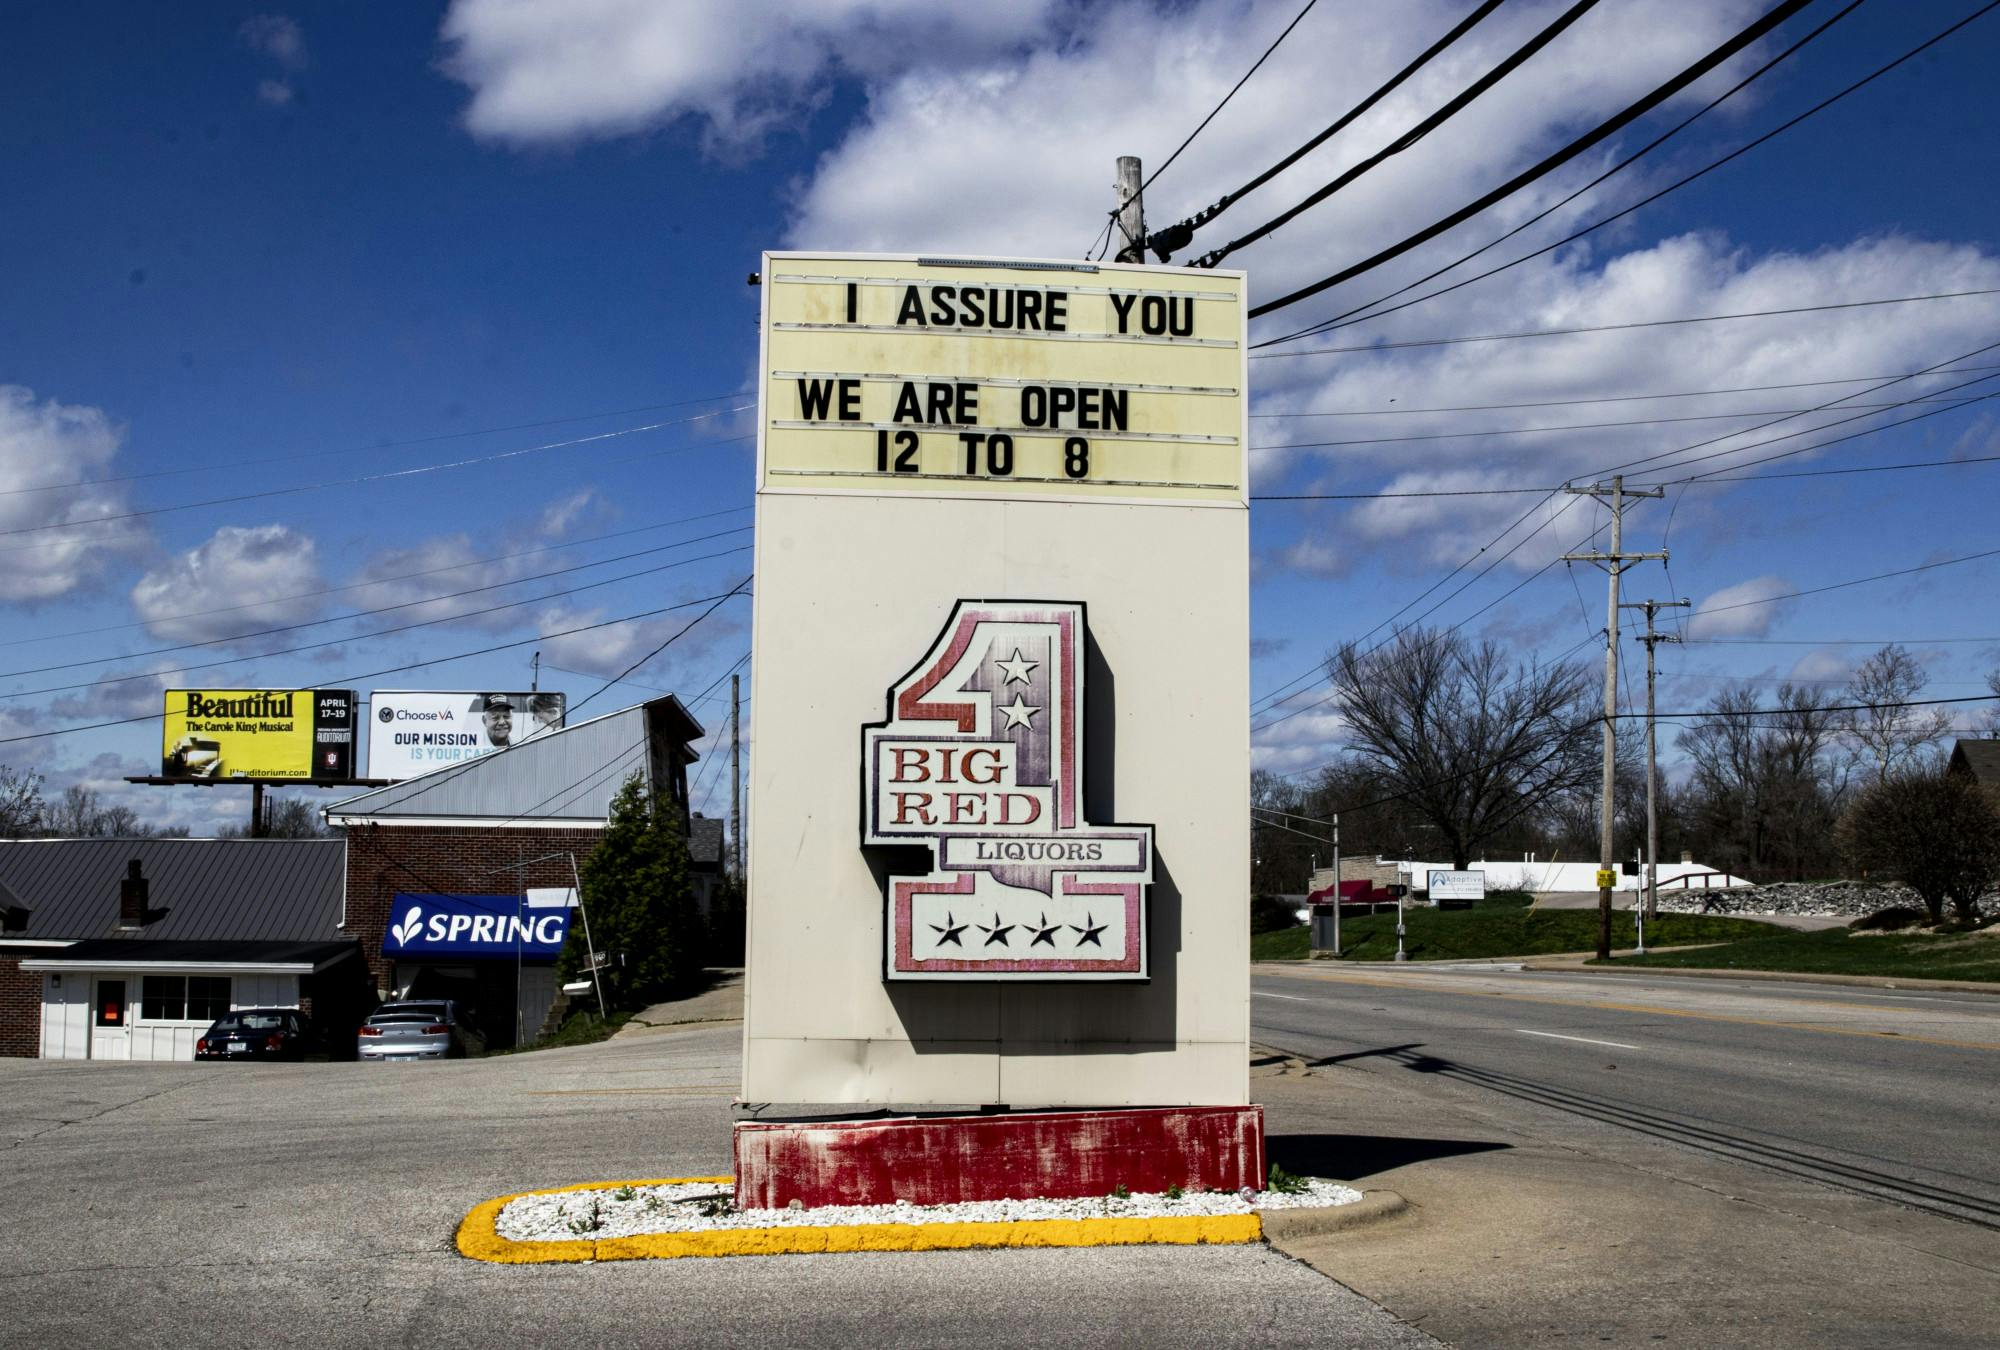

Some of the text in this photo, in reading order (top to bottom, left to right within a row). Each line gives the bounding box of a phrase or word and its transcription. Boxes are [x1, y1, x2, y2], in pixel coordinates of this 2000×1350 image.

[846, 283, 1194, 337] I ASSURE YOU
[797, 378, 1128, 431] WE ARE OPEN
[876, 429, 1089, 479] 12 TO 8
[186, 692, 294, 718] Beautiful
[320, 699, 348, 708] APRIL
[186, 721, 294, 734] The Carole King Musical
[394, 733, 477, 746] OUR MISSION
[411, 747, 497, 761] IS YOUR CA
[888, 747, 1009, 784] BIG
[889, 791, 1042, 826] RED
[975, 841, 1103, 861] LIQUORS
[425, 913, 564, 944] SPRING
